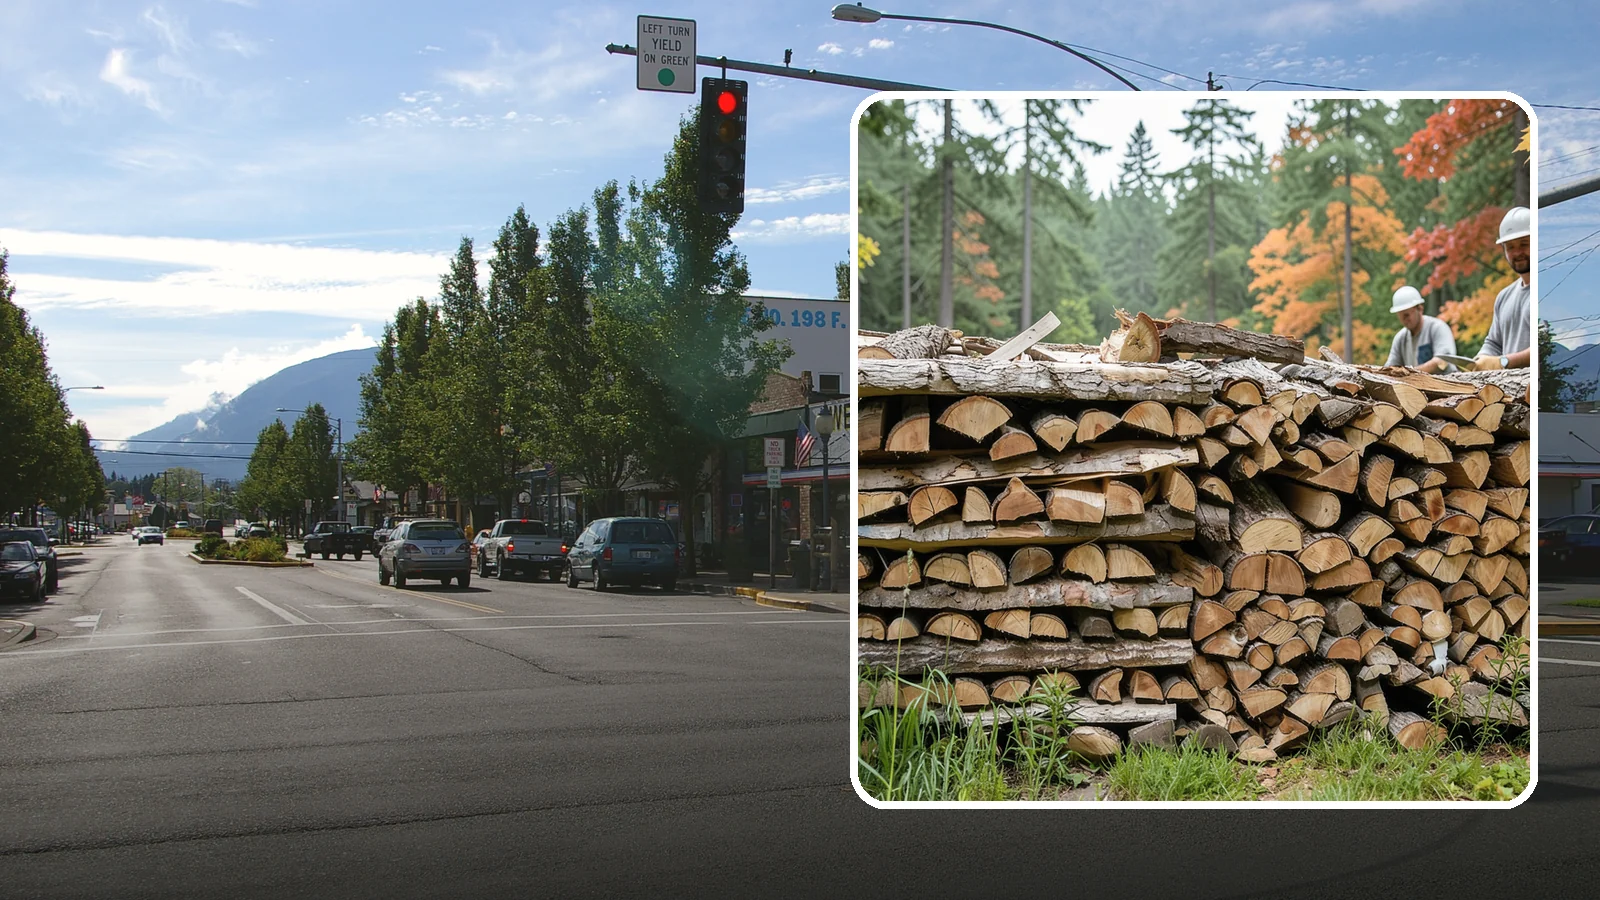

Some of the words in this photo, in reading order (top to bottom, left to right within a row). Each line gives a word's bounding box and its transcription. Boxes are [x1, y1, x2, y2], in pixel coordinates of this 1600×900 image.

[643, 23, 663, 34] LEFT
[668, 25, 690, 36] TURN
[652, 37, 682, 51] YIELD
[644, 53, 656, 63] ON
[661, 54, 689, 66] GREEN
[791, 309, 826, 328] 198
[831, 311, 846, 329] F.
